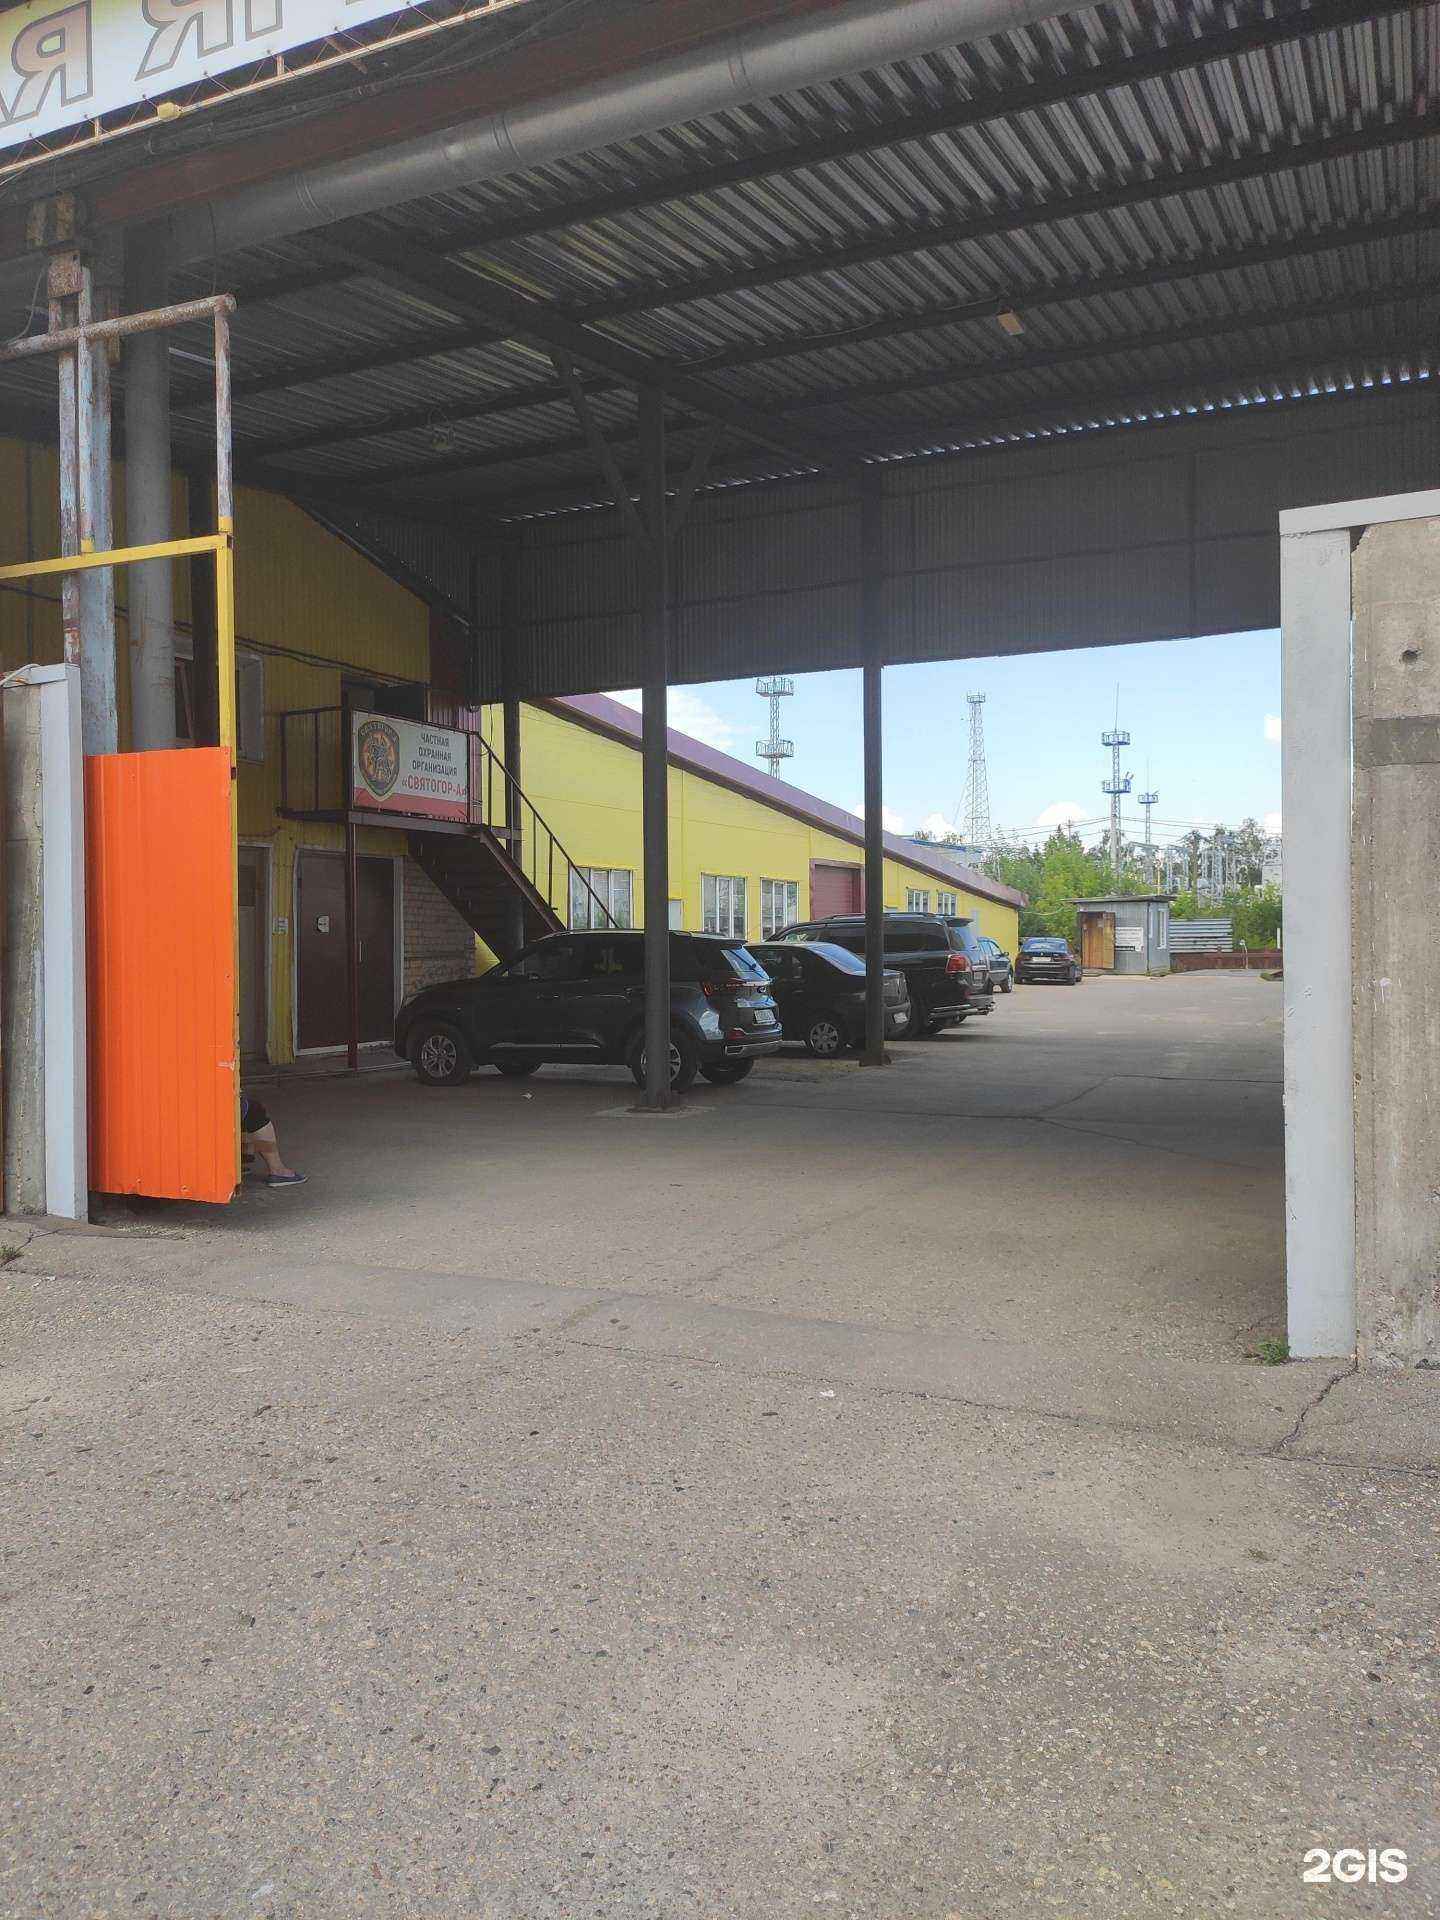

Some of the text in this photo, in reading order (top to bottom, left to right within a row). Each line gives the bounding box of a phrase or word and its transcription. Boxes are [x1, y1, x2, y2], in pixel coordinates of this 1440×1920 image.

[420, 733, 449, 747] ЧАСТНАЯ
[418, 746, 452, 761] ОХРАННАЯ
[412, 760, 458, 776] ОРГАНИЗАЦИЯ
